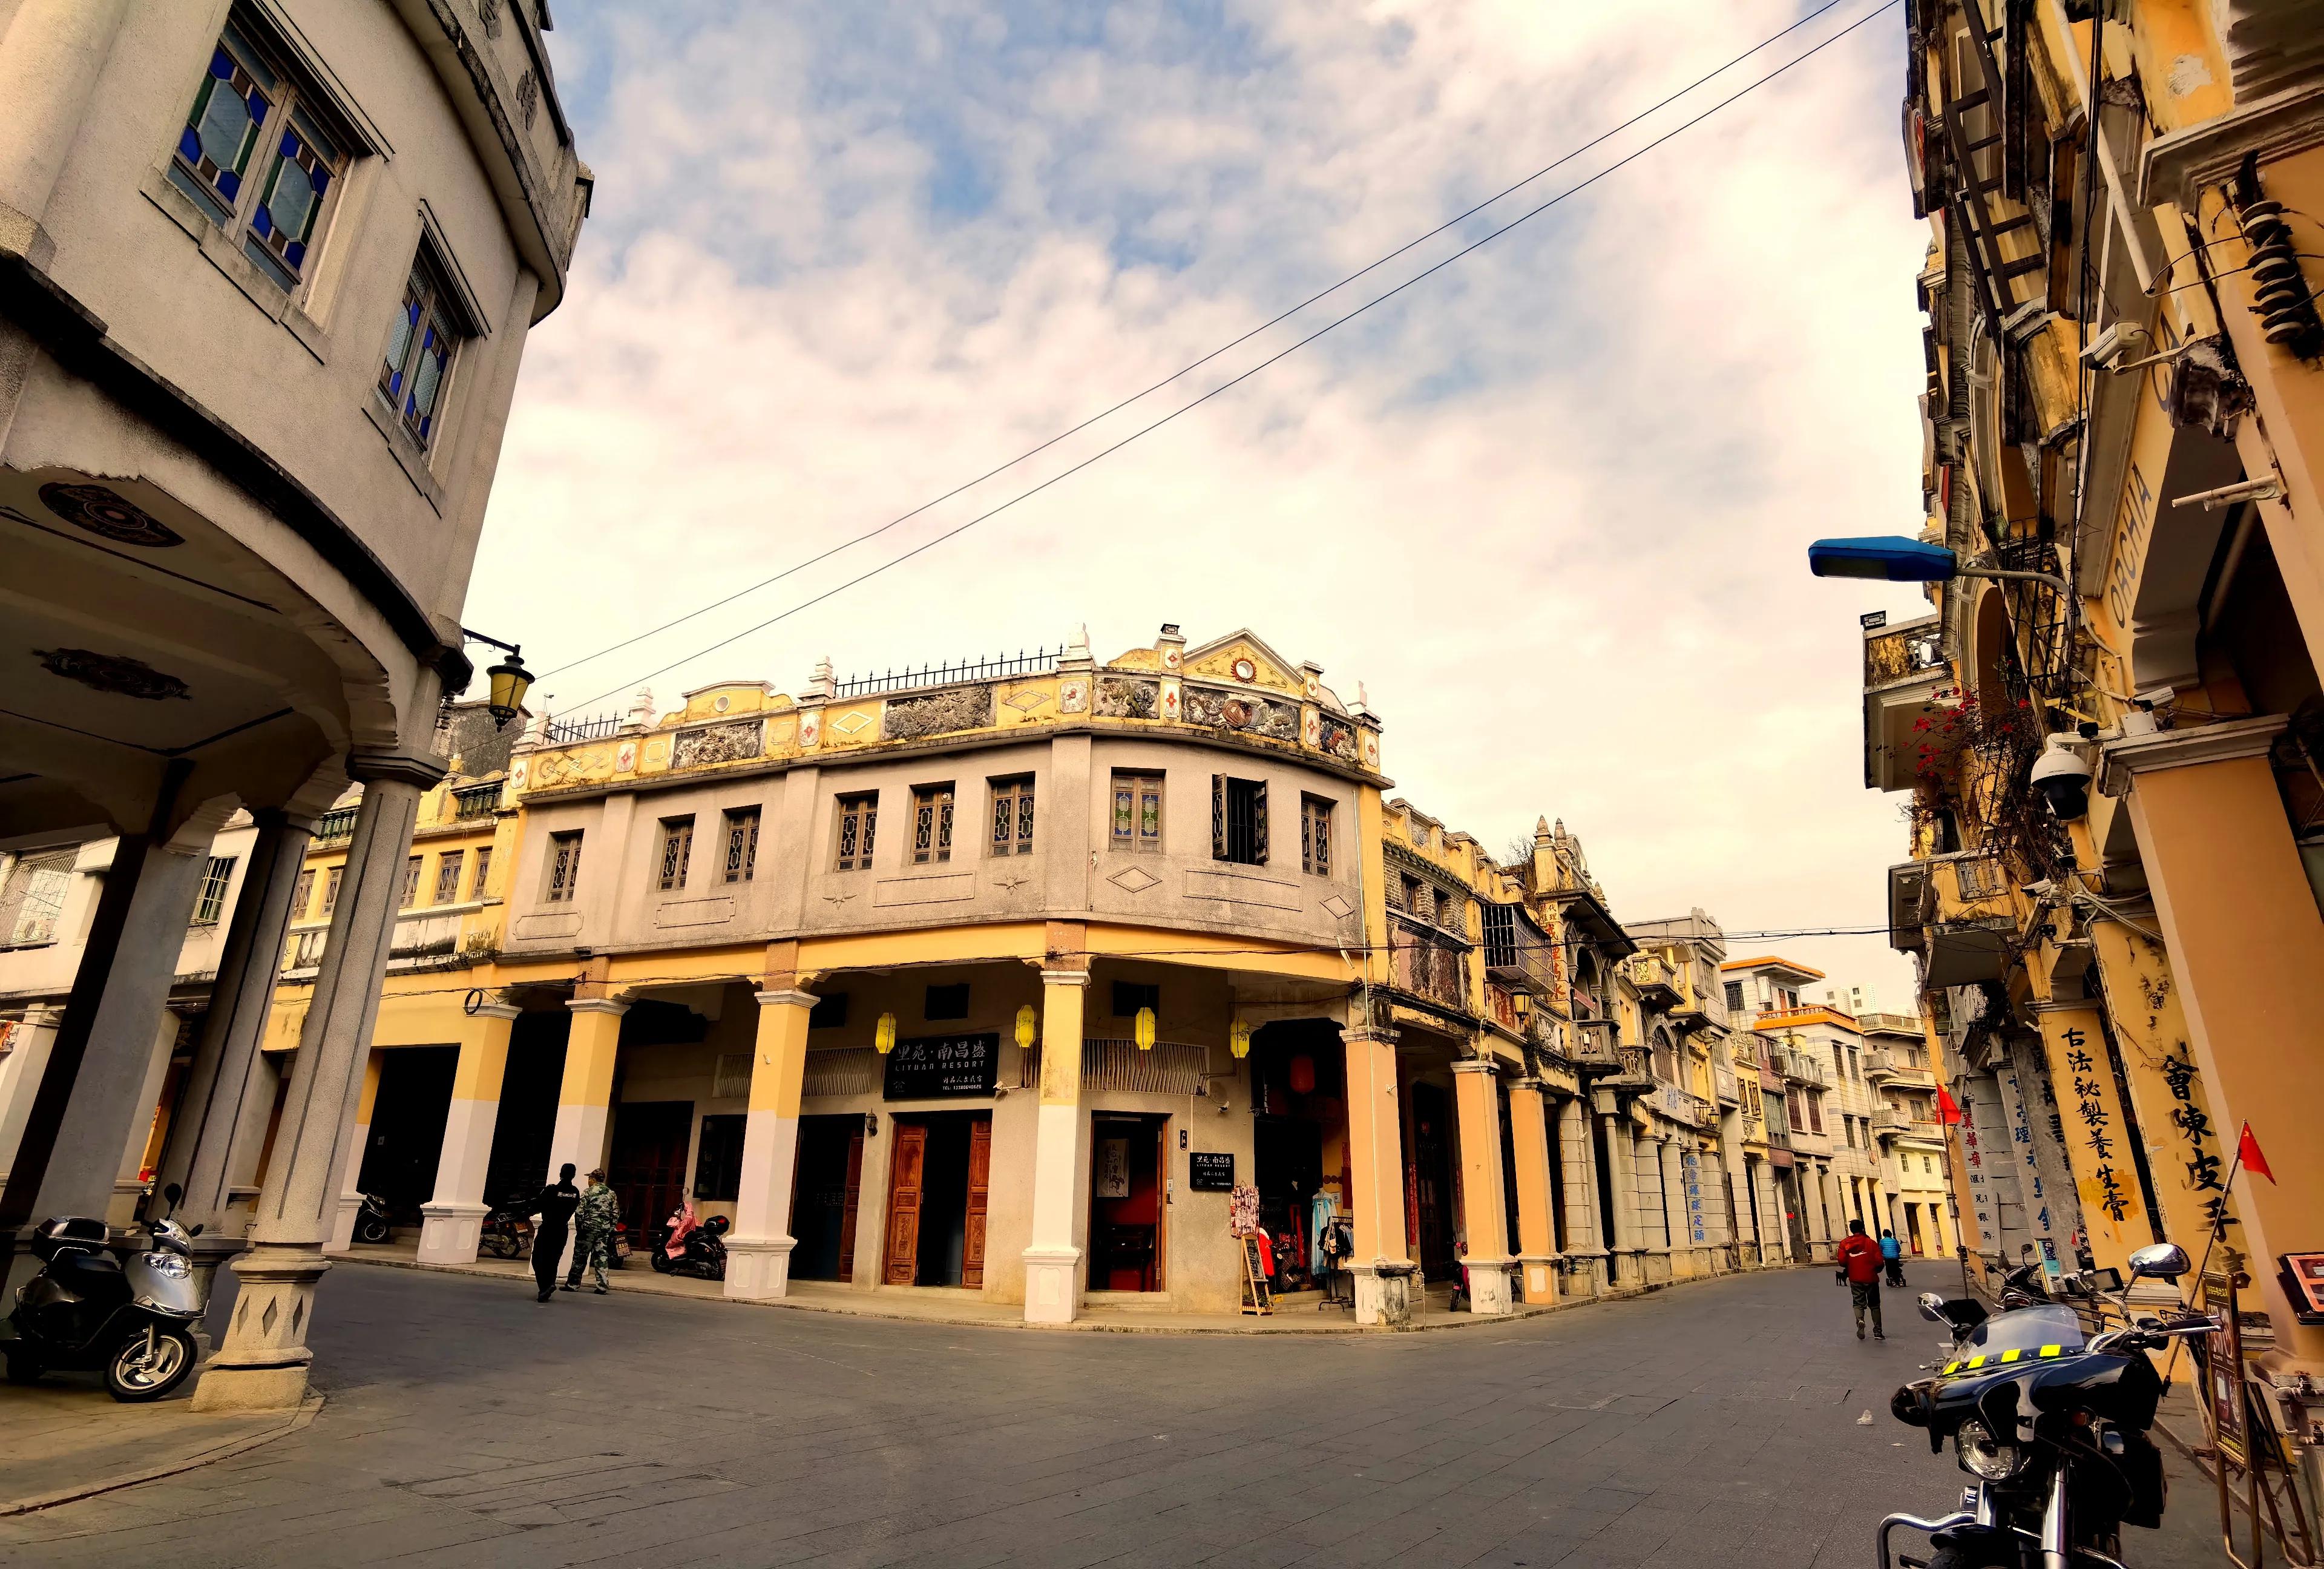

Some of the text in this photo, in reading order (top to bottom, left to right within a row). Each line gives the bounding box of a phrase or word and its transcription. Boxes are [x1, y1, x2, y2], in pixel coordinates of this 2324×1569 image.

[942, 1061, 984, 1069] RESORT
[2061, 1027, 2129, 1222] 古法秘製養生膏
